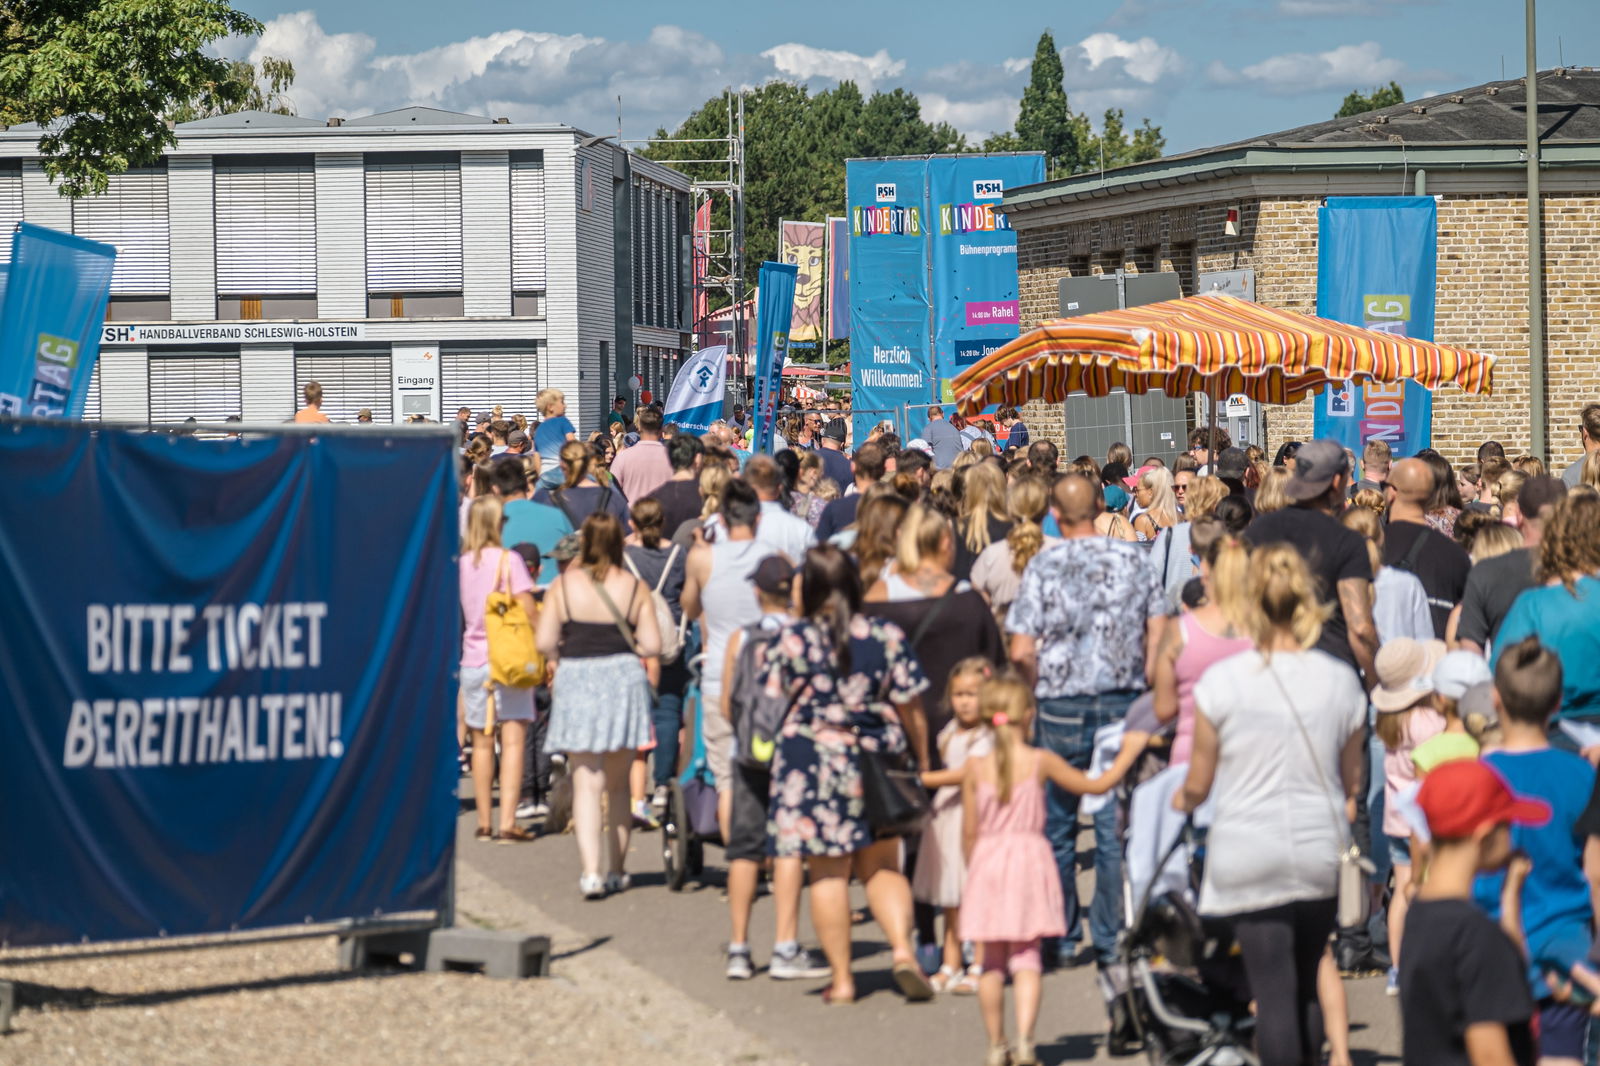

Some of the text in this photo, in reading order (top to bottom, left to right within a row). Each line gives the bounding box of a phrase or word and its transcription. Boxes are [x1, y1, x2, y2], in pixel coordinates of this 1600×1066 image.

[877, 186, 895, 196] RSH
[976, 183, 1000, 193] RSH
[854, 209, 918, 233] KINDERTAG
[942, 205, 1012, 231] KINDER
[992, 306, 1014, 318] Rahel
[101, 328, 129, 342] SH
[140, 326, 358, 340] HANDBALLVERBAND SCHLESWIG-HOLSTEIN
[873, 345, 911, 364] Herzlich
[398, 376, 435, 386] Eingang
[861, 368, 923, 388] Willkommen!
[86, 602, 328, 674] BITTE TICKET
[62, 691, 345, 768] BEREITHALTEN!
